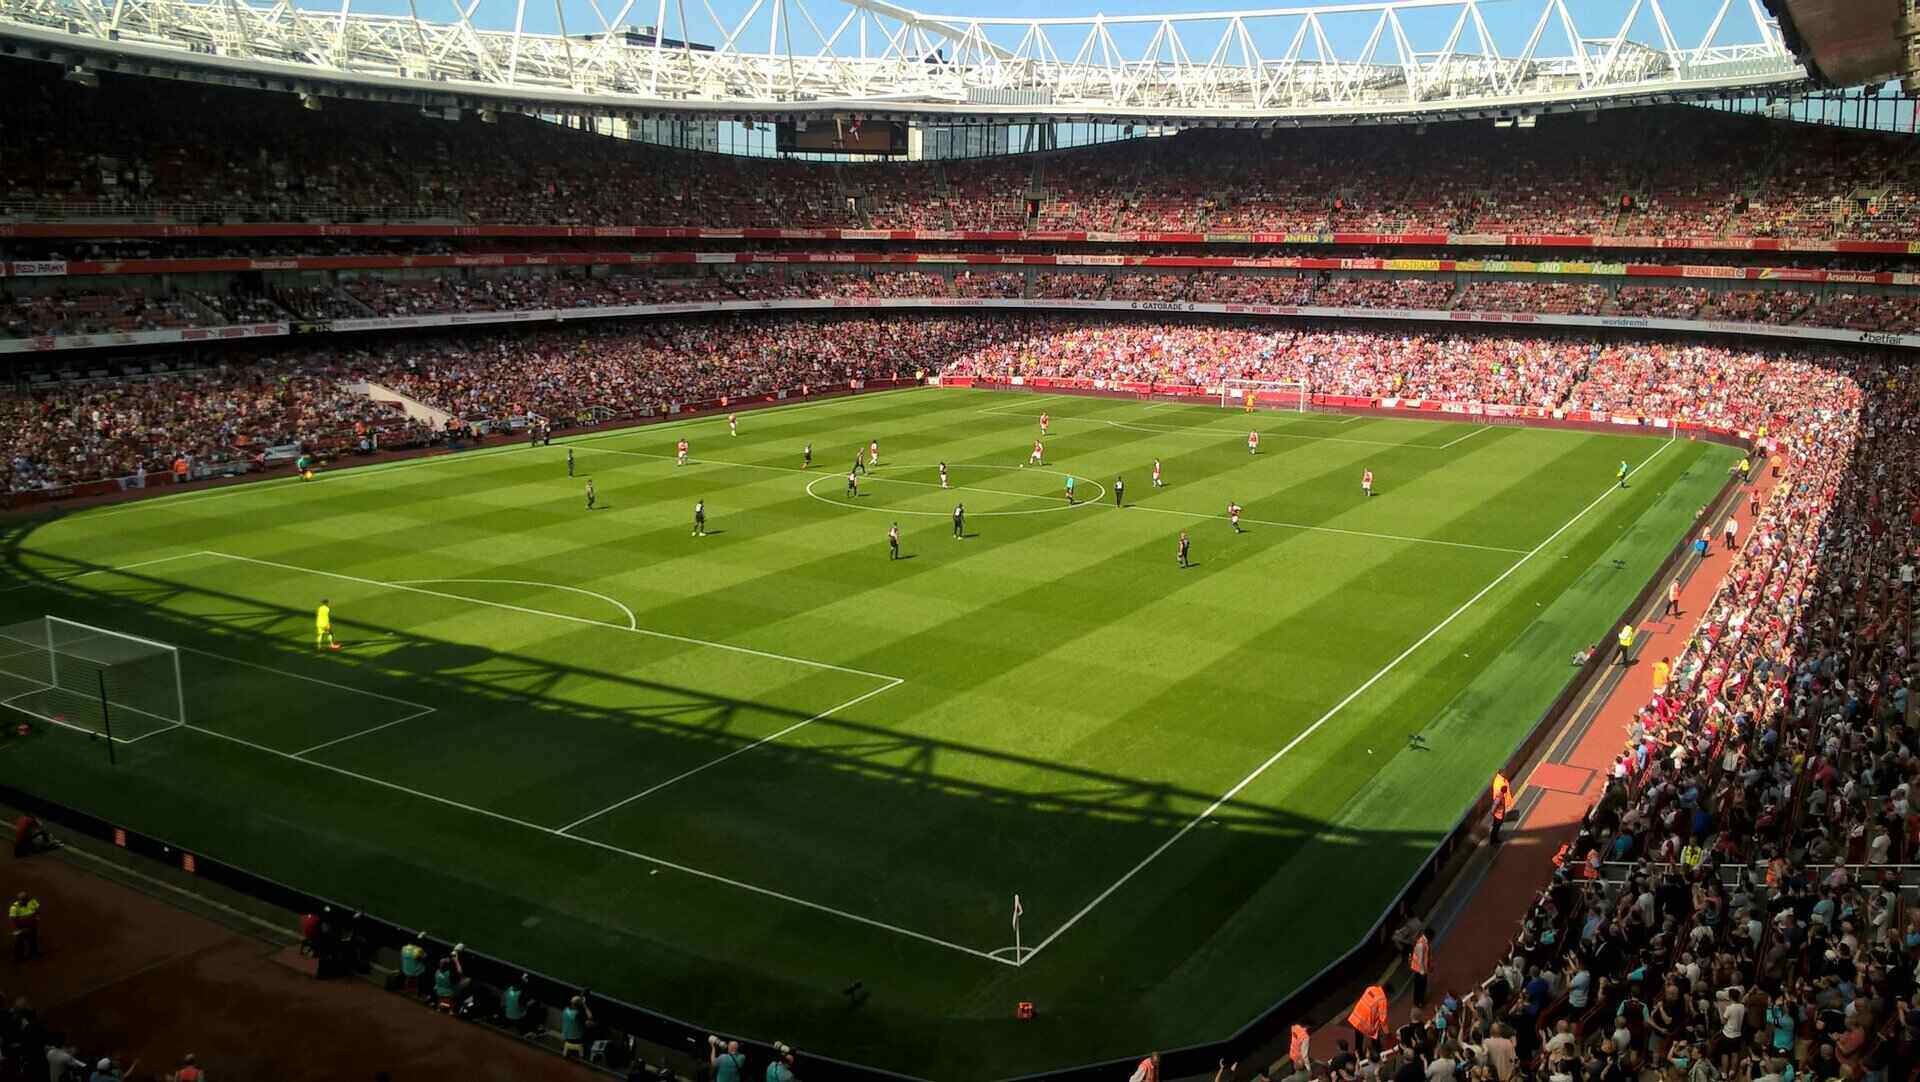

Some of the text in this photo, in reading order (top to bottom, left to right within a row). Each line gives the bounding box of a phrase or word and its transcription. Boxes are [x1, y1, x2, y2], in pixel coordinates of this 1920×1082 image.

[16, 262, 35, 273] RED
[1825, 271, 1876, 283] Arsenal.com
[1143, 302, 1182, 310] GATORADE
[1600, 318, 1649, 328] worldremit
[1867, 333, 1905, 346] betfair
